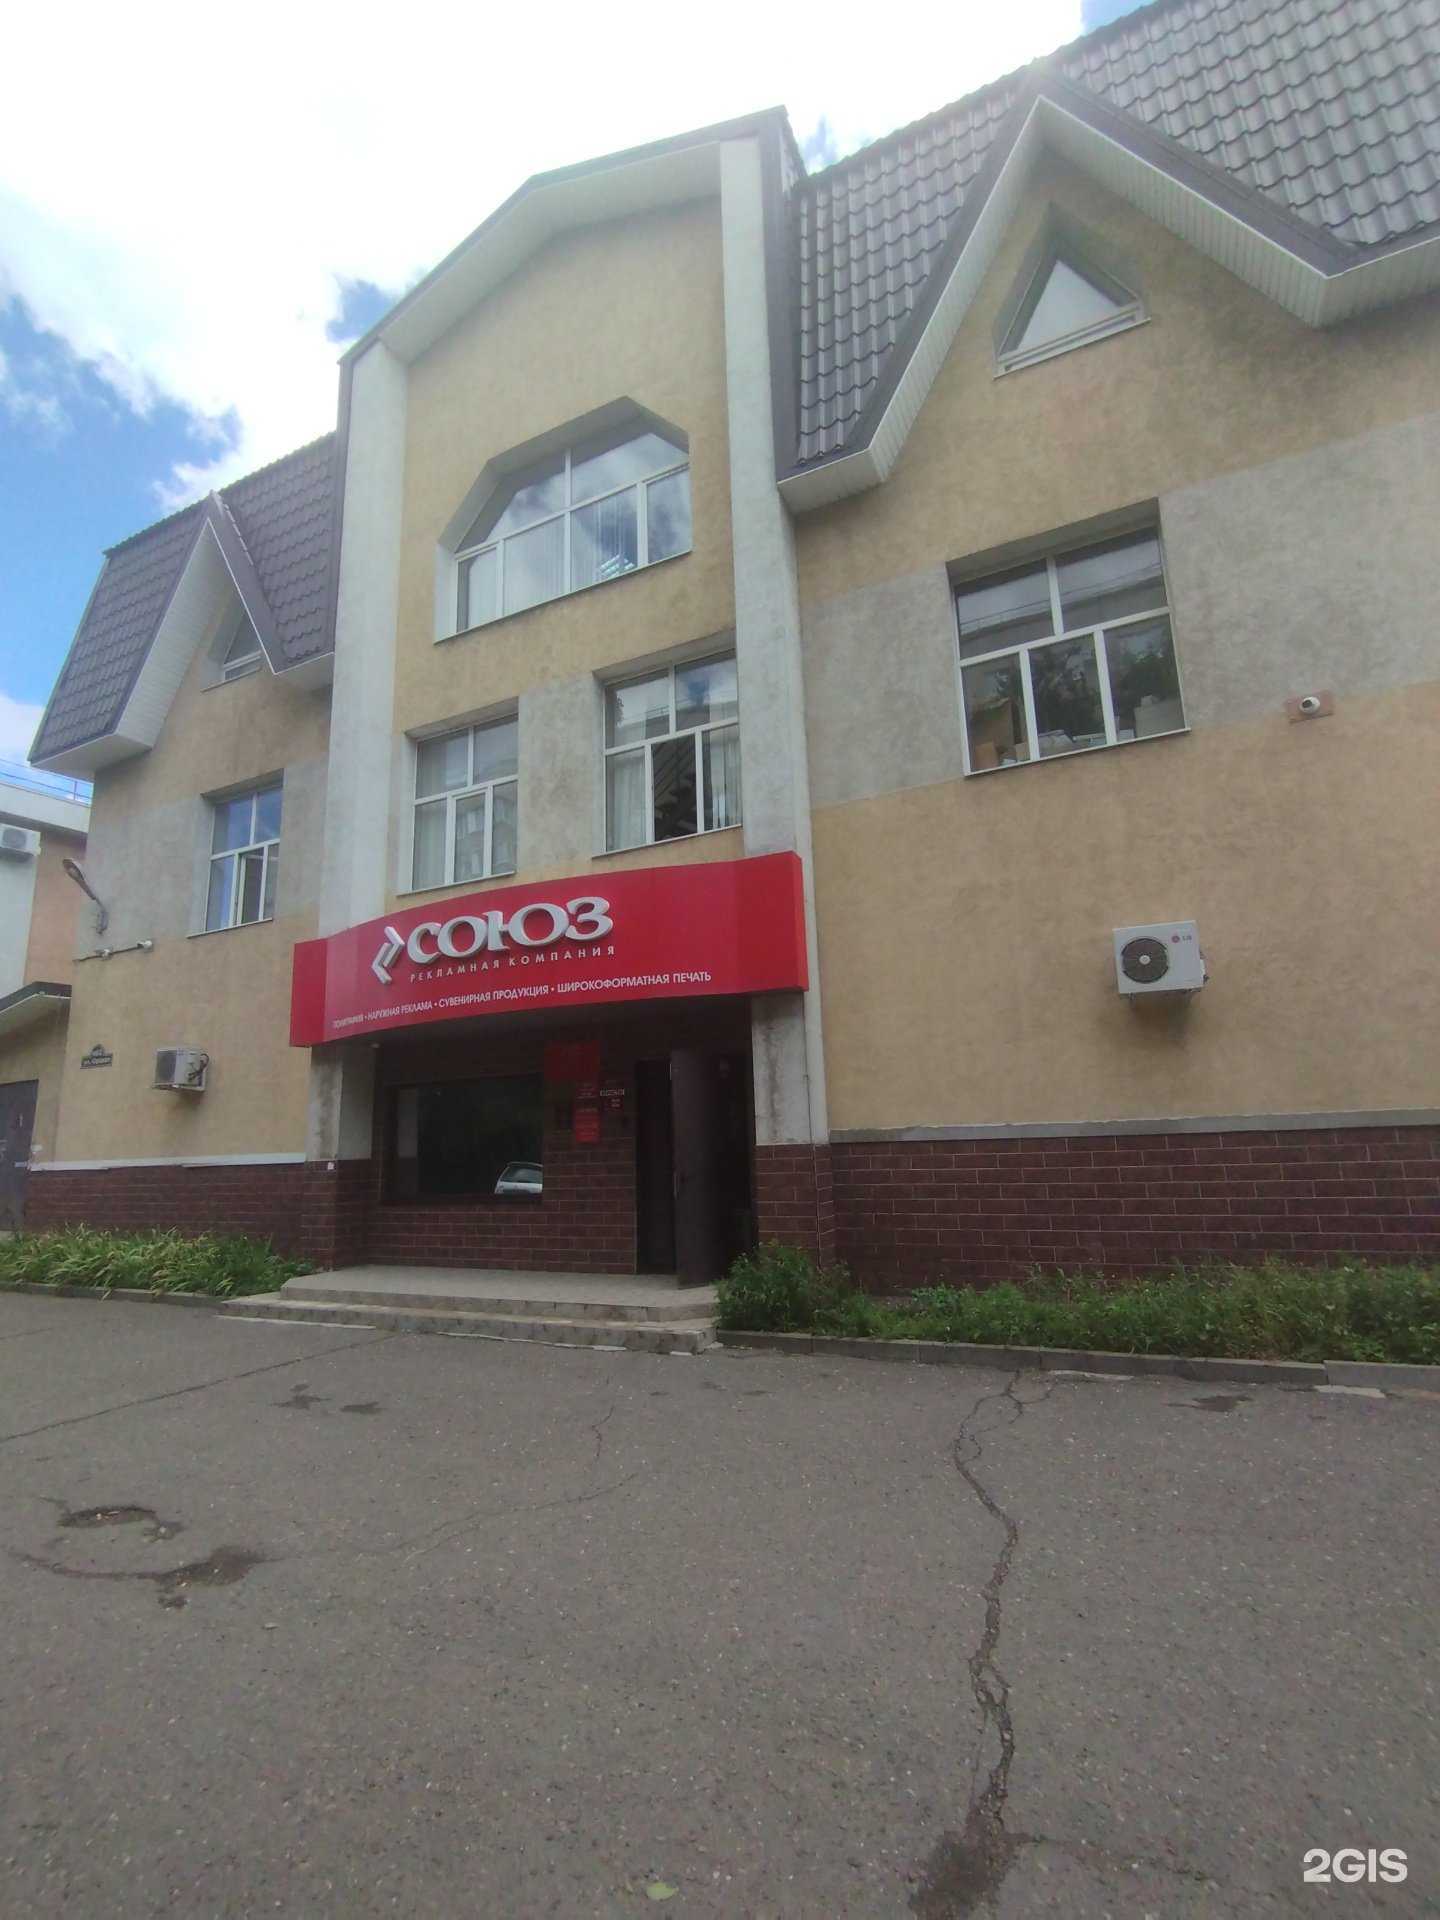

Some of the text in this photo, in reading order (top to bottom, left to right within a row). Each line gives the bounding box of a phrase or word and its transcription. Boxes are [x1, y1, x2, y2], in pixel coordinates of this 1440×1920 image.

[407, 896, 613, 964] СОЮЗ
[410, 945, 615, 983] РЕКЛАМНАЯ КОМПАНИЯ
[367, 1006, 400, 1021] НАРУЖНАЯ
[401, 1001, 433, 1015] РЕКЛАМА
[439, 991, 491, 1008] СУВЕНИРНАЯ
[493, 984, 549, 1000] ПРОДУКЦИЯ
[557, 973, 670, 993] ШИРОКОФОРМАТНАЯ
[672, 971, 712, 984] ПЕЧАТЬ
